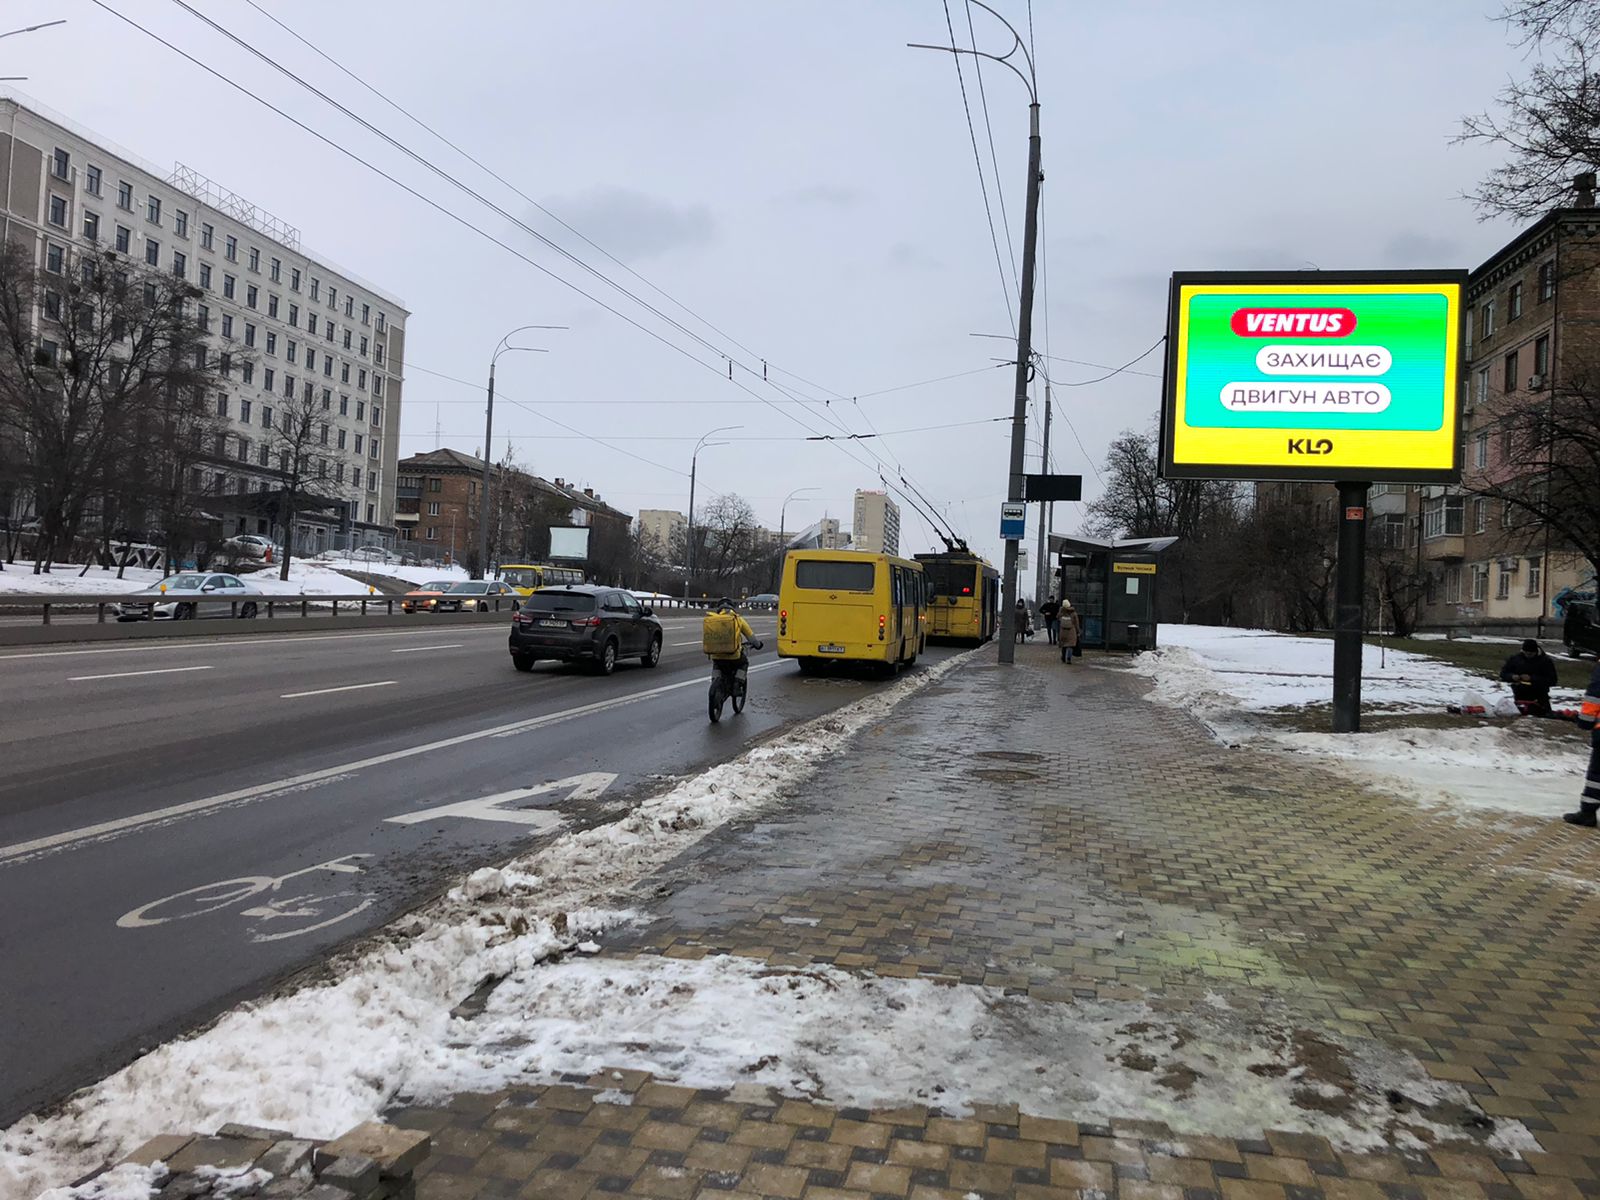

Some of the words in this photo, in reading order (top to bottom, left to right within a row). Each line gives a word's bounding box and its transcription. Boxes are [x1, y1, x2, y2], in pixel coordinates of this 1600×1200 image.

[1246, 313, 1343, 332] VENTUS
[1266, 352, 1381, 370] ЗАХИЩАЄ
[1231, 389, 1317, 406] ДВИГУН
[1323, 390, 1380, 405] АВТО
[1288, 439, 1333, 454] KLO
